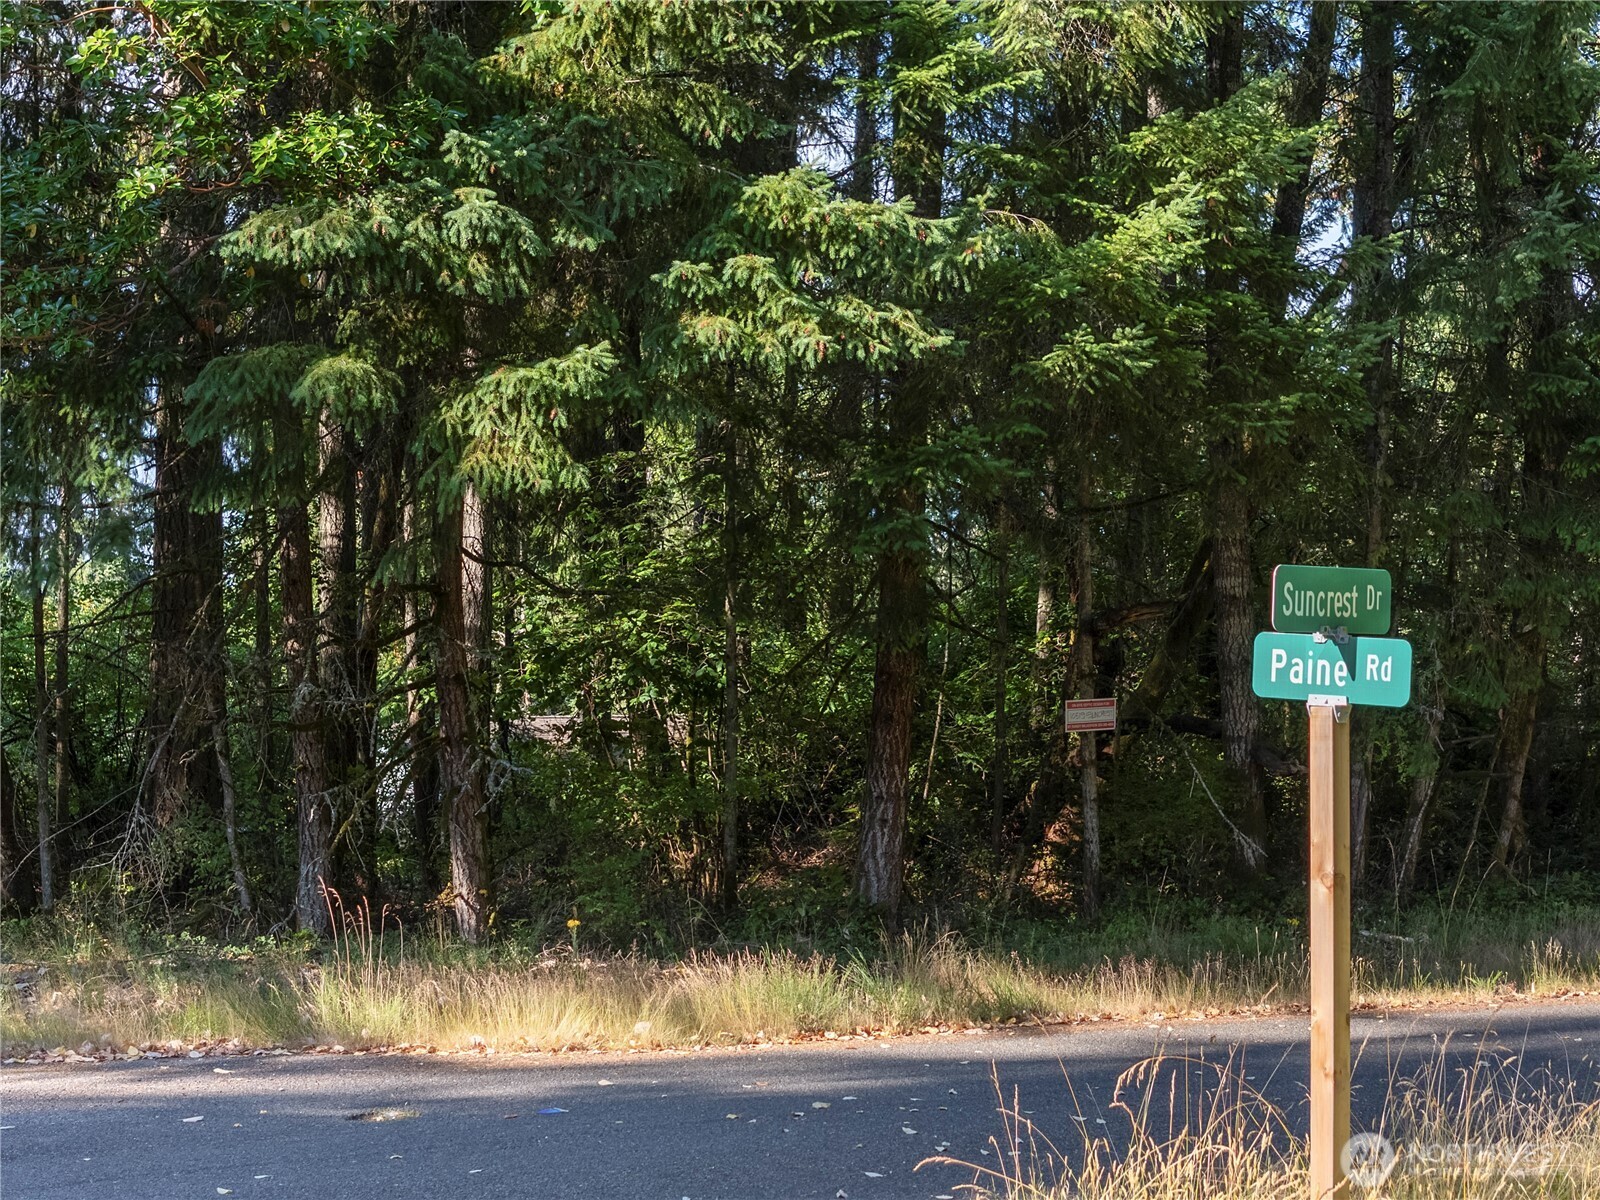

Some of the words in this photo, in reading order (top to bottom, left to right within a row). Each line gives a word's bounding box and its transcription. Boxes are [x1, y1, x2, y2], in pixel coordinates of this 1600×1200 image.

[1282, 582, 1358, 618] Suncrest
[1366, 585, 1382, 610] Dr
[1271, 648, 1347, 687] Paine
[1366, 654, 1393, 682] Rd
